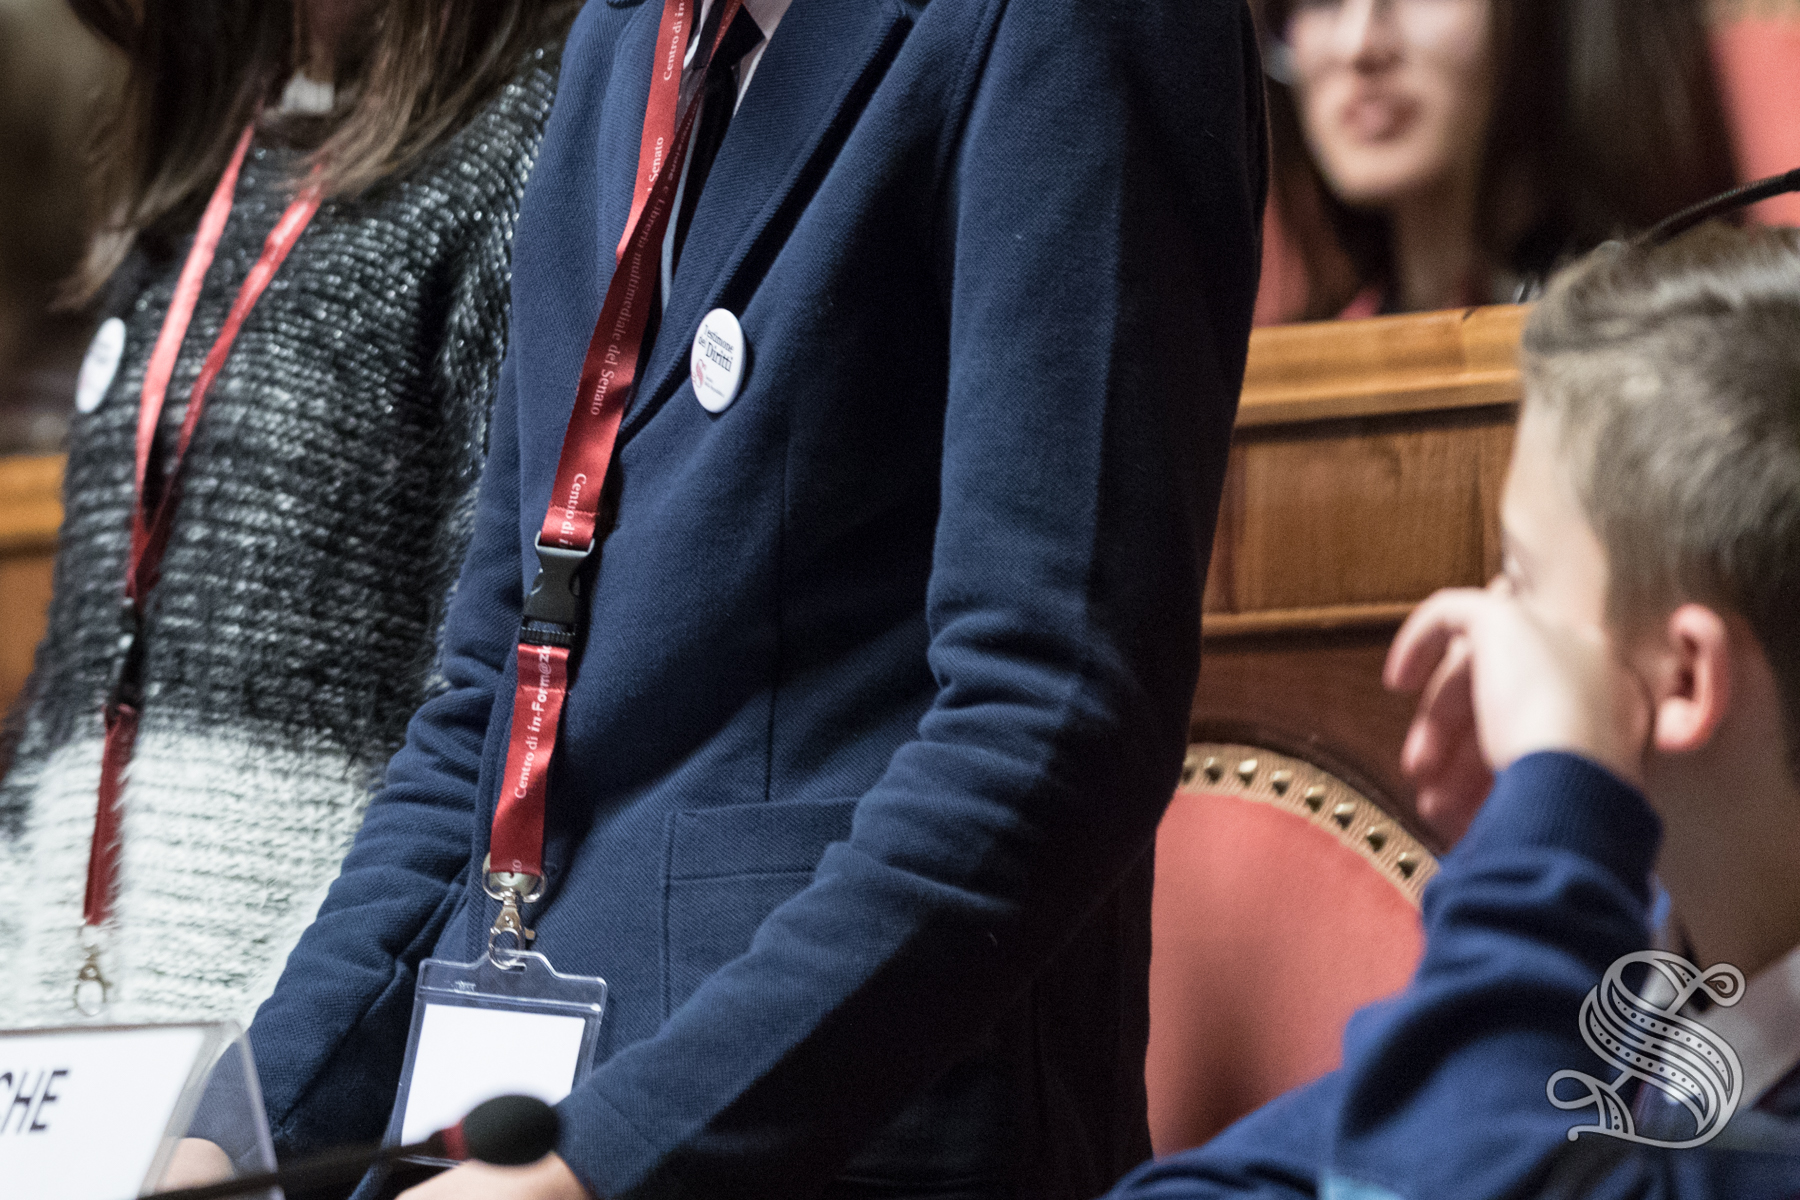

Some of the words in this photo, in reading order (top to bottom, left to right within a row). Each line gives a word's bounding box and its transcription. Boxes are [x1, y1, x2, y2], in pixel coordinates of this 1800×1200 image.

[663, 35, 679, 81] Centro
[672, 20, 683, 33] di
[648, 136, 664, 182] Senato
[637, 198, 666, 249] Libreria
[611, 251, 642, 341] multimediale
[604, 343, 621, 366] del
[705, 341, 734, 373] Diritti
[590, 368, 615, 416] Senato
[565, 473, 587, 519] Centro
[560, 520, 576, 535] di
[514, 752, 535, 799] Centro
[525, 736, 538, 750] di
